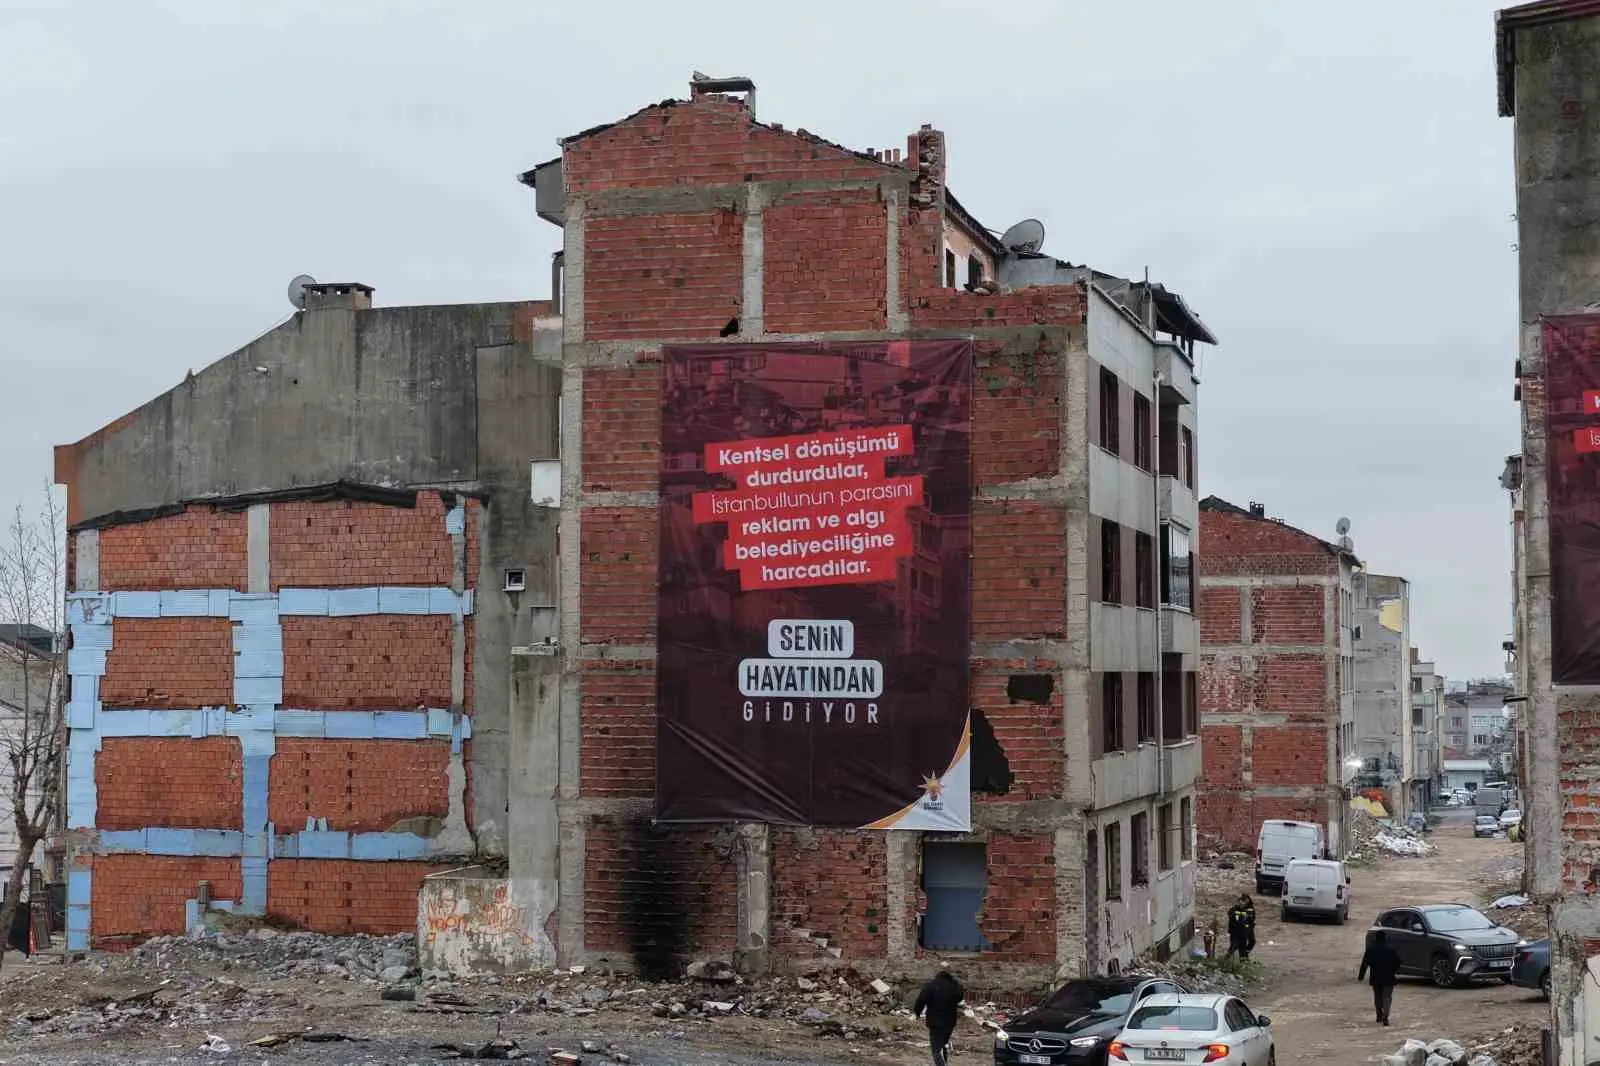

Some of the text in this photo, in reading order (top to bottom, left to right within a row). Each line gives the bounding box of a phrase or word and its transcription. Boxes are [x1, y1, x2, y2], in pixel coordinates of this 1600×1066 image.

[719, 433, 899, 466] Kentsel dönüşümü
[746, 463, 868, 487] durdurdular,
[712, 484, 913, 514] İstanbullunun parasını
[742, 509, 884, 535] reklam ve algı
[735, 533, 895, 560] belediyeciliğine
[762, 559, 871, 581] harcadılar.
[747, 664, 875, 693] HAYATINDAN
